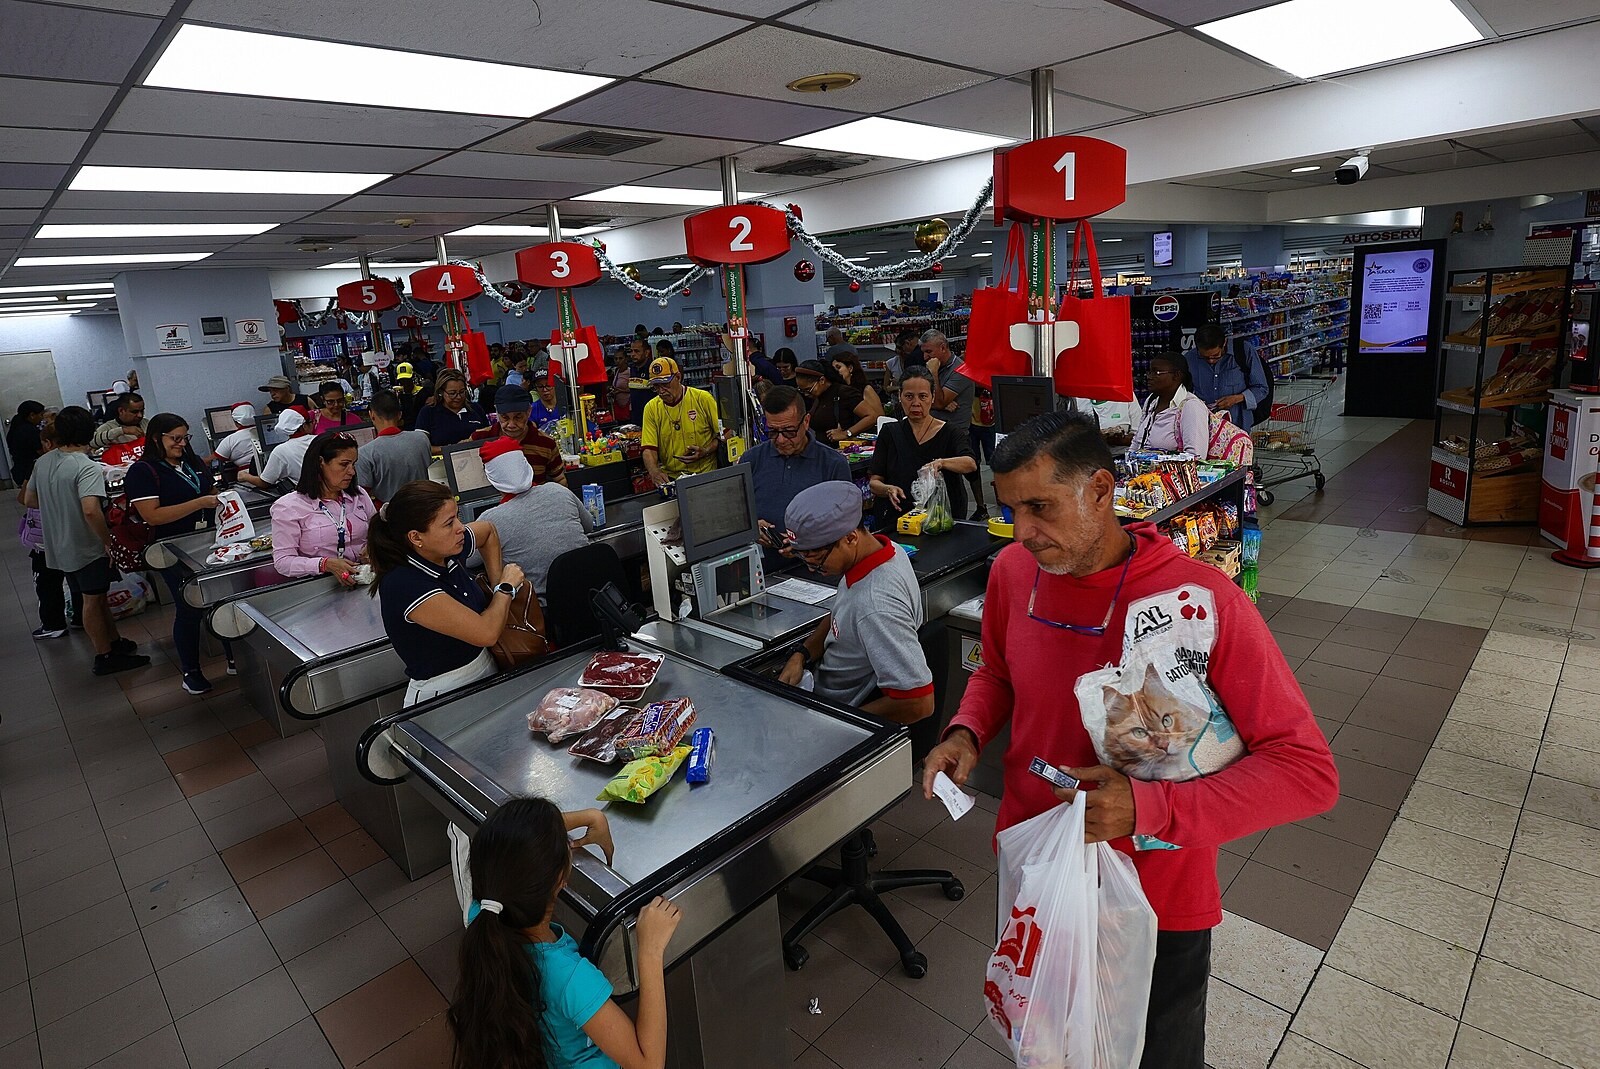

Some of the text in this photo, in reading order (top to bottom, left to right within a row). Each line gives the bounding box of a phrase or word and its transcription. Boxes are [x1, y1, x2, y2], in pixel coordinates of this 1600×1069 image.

[1053, 152, 1076, 201] 1
[729, 215, 754, 252] 2
[549, 250, 571, 279] 3
[437, 271, 456, 294] 4
[362, 285, 377, 305] 5
[1154, 304, 1178, 313] PEPSI
[400, 318, 408, 327] 10
[1555, 420, 1566, 434] SAN
